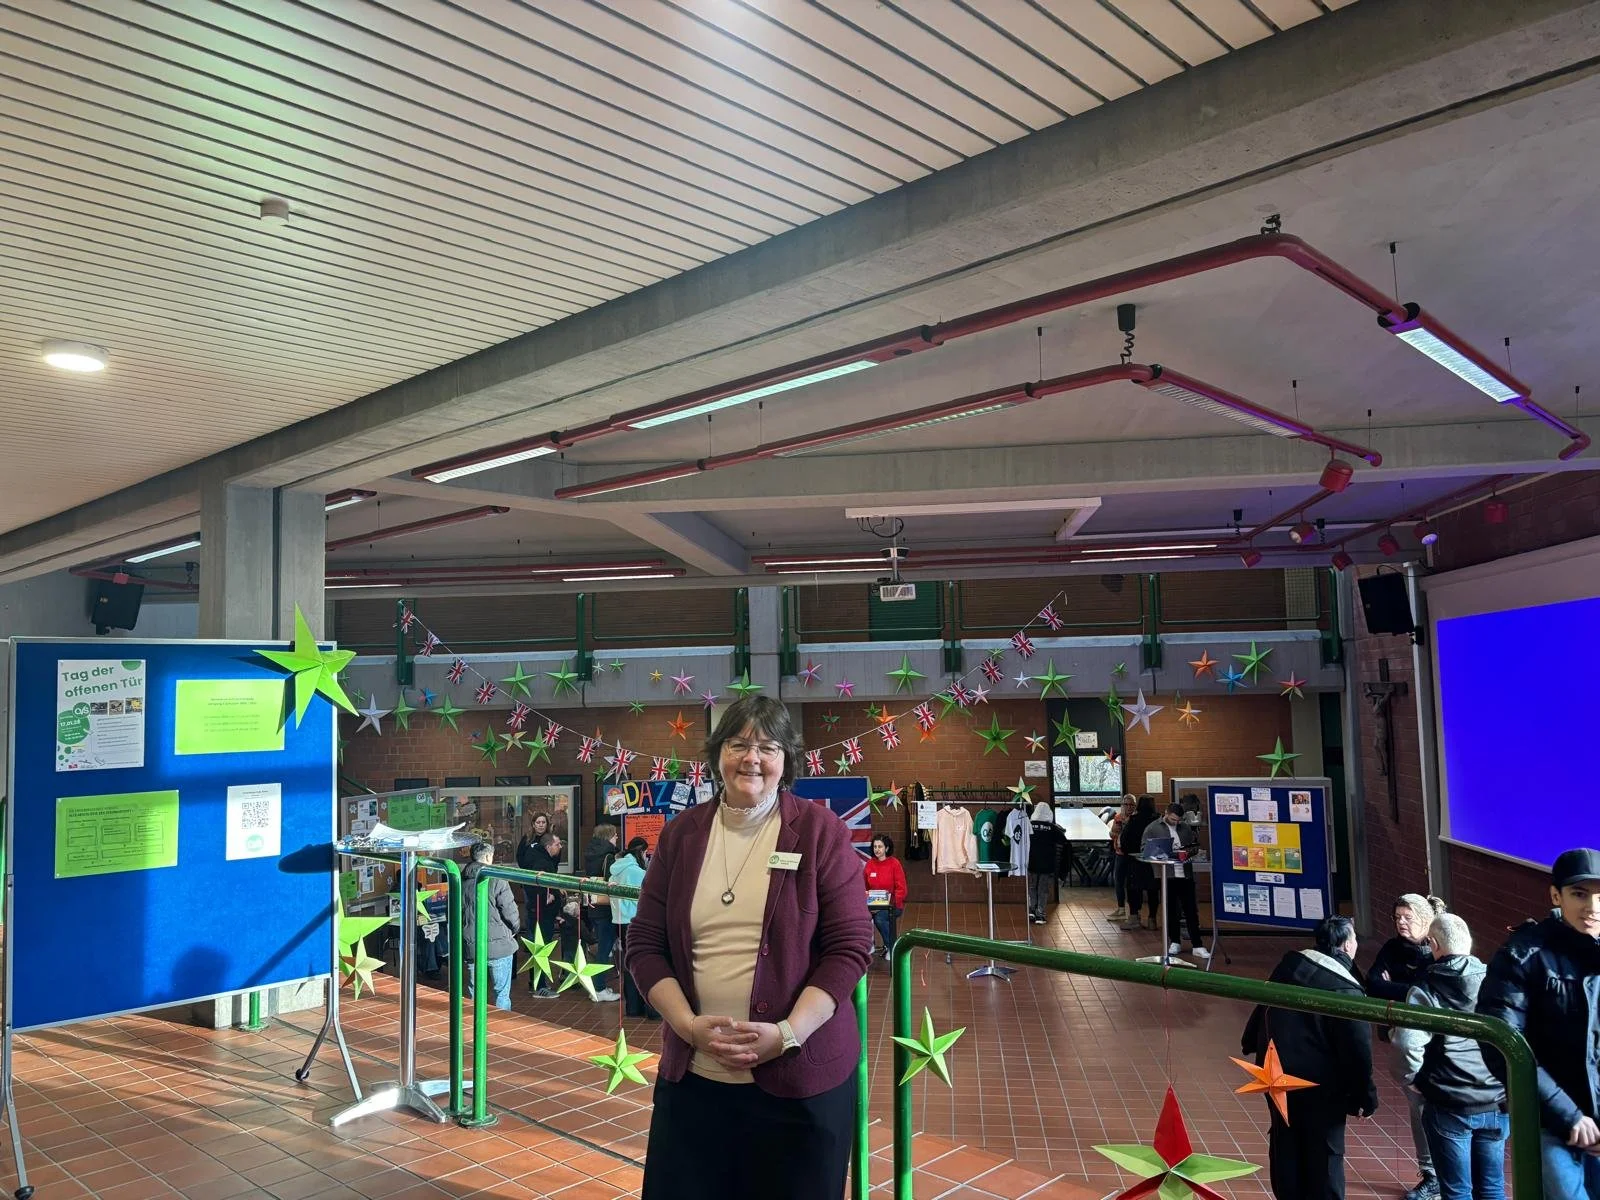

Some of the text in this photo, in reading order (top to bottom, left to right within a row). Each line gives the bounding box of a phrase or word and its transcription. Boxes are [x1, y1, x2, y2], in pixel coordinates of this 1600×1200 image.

[62, 666, 114, 682] Tag der
[65, 676, 143, 698] offenen Tür
[622, 781, 671, 808] DAZ
